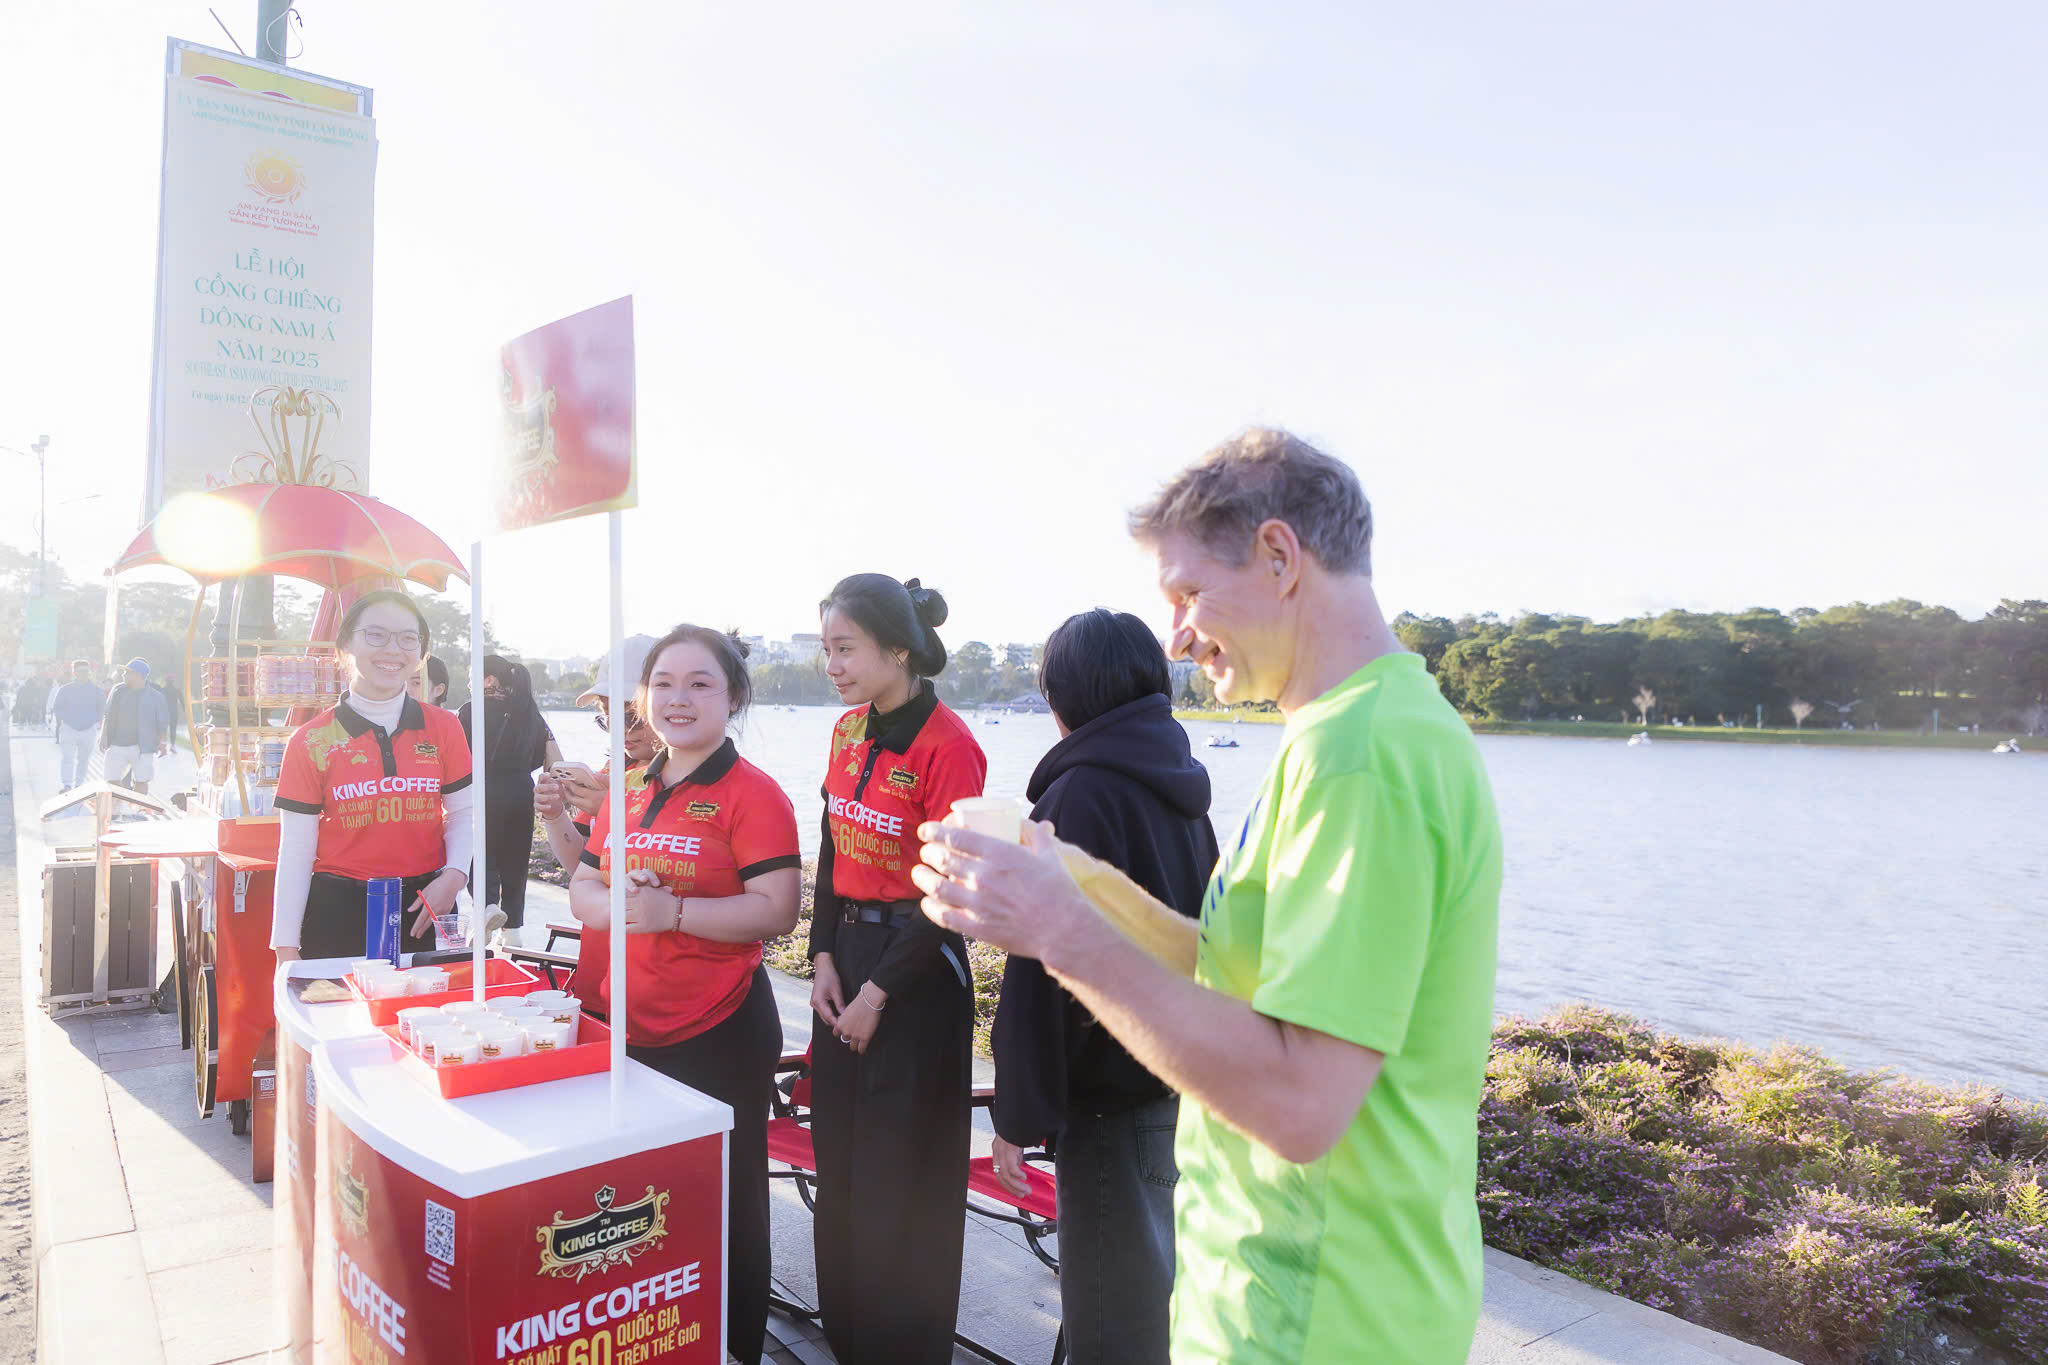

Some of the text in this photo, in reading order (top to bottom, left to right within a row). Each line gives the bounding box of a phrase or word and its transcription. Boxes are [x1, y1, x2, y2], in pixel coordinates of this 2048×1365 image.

[234, 247, 305, 280] LỄ HỘI
[194, 271, 342, 313] CỒNG CHIÊNG
[270, 317, 316, 339] NAM
[319, 320, 336, 342] Á
[216, 337, 320, 369] NĂM 2025
[333, 776, 441, 800] KING COFFEE
[376, 796, 403, 824] 60
[845, 800, 904, 837] COFFEE
[625, 832, 702, 856] COFFEE
[856, 832, 880, 854] QUỐC
[881, 840, 901, 856] GIA
[674, 860, 697, 878] GIA
[560, 1216, 649, 1256] KING COFFEE
[339, 1249, 406, 1357] COFFEE
[497, 1260, 701, 1359] KING COFFEE
[617, 1304, 681, 1347] QUỐC GIA
[616, 1320, 700, 1365] TRÊN THẾ GIỚI
